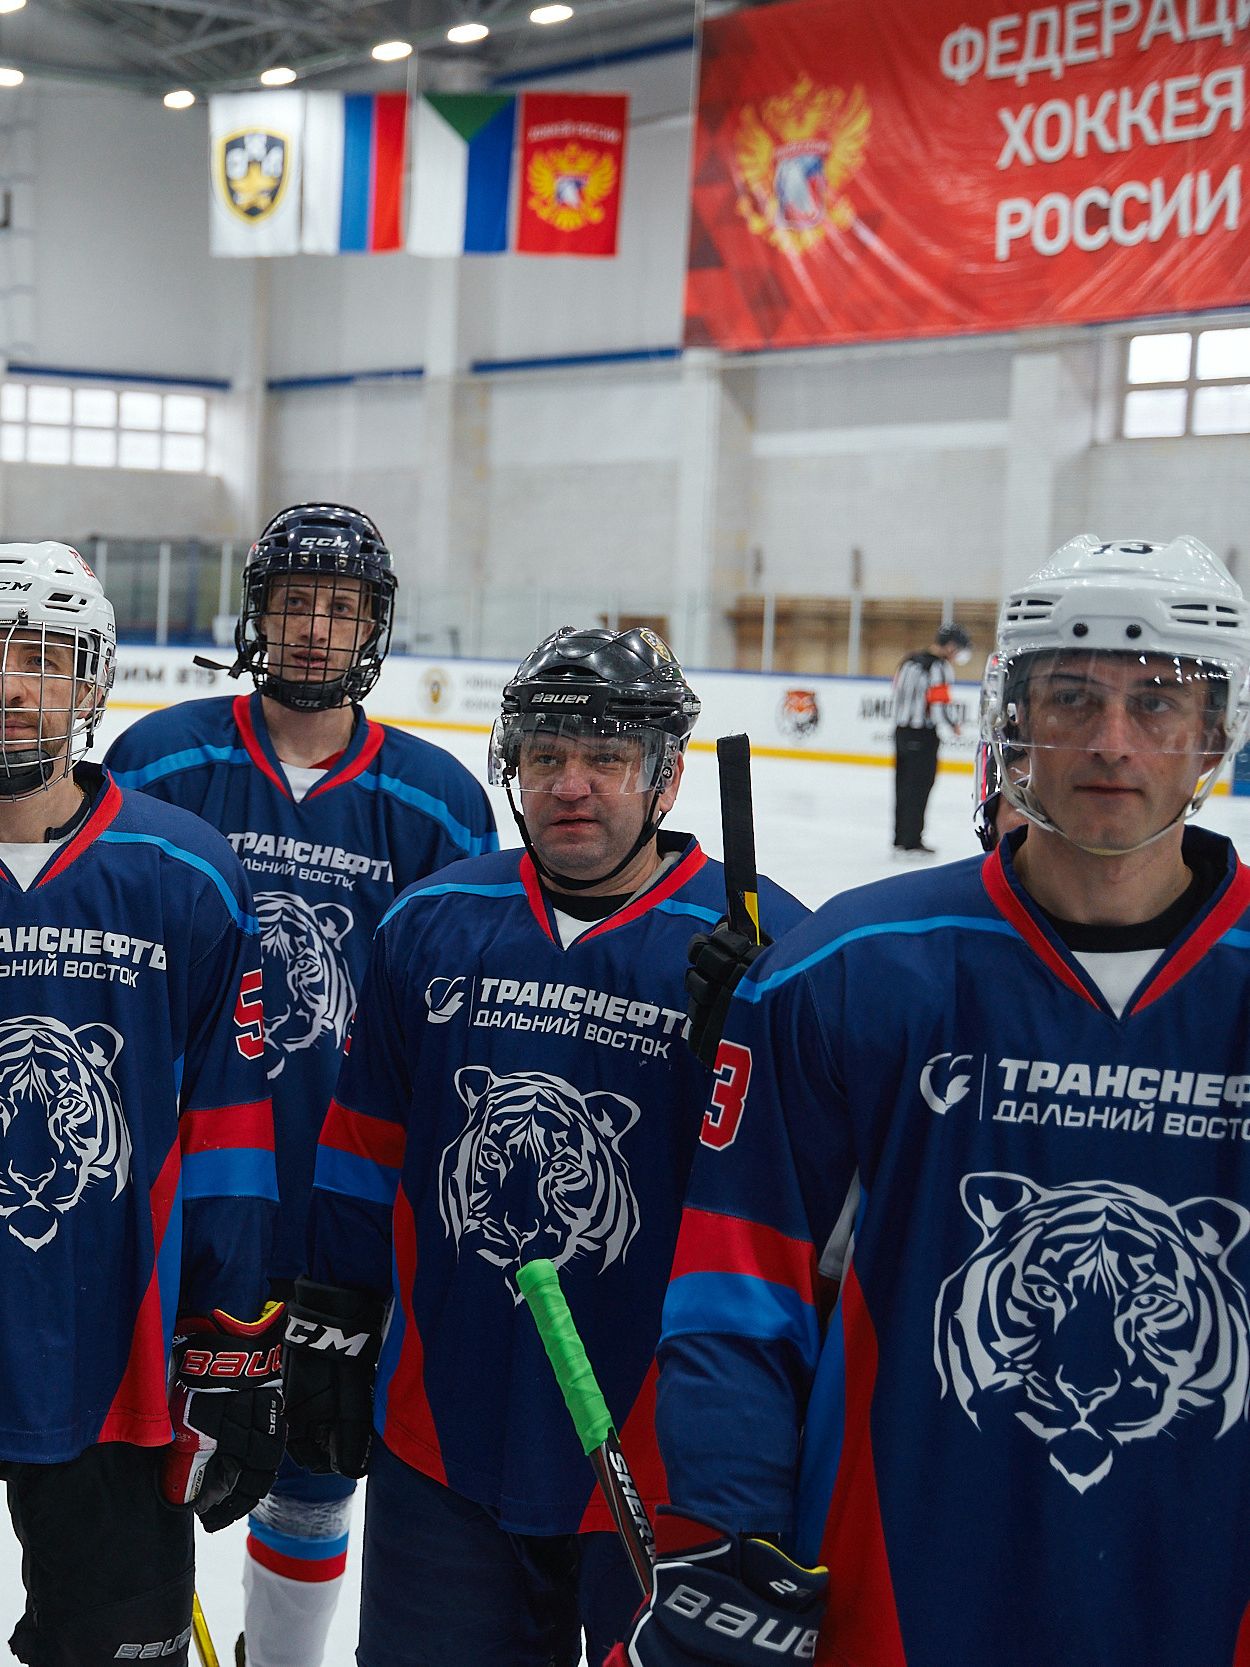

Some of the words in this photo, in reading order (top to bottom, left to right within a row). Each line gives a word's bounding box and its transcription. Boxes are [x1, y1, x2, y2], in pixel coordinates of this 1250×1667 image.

[996, 65, 1245, 171] ХОККЕЯ
[995, 164, 1241, 263] РОССИИ
[300, 537, 351, 549] CCM
[531, 692, 591, 705] BAUER
[62, 961, 140, 988] ВОСТОК
[473, 1009, 580, 1037] ДАЛЬНИЙ
[584, 1023, 672, 1059] ВОСТОК
[992, 1100, 1156, 1133] ДАЛЬНИЙ
